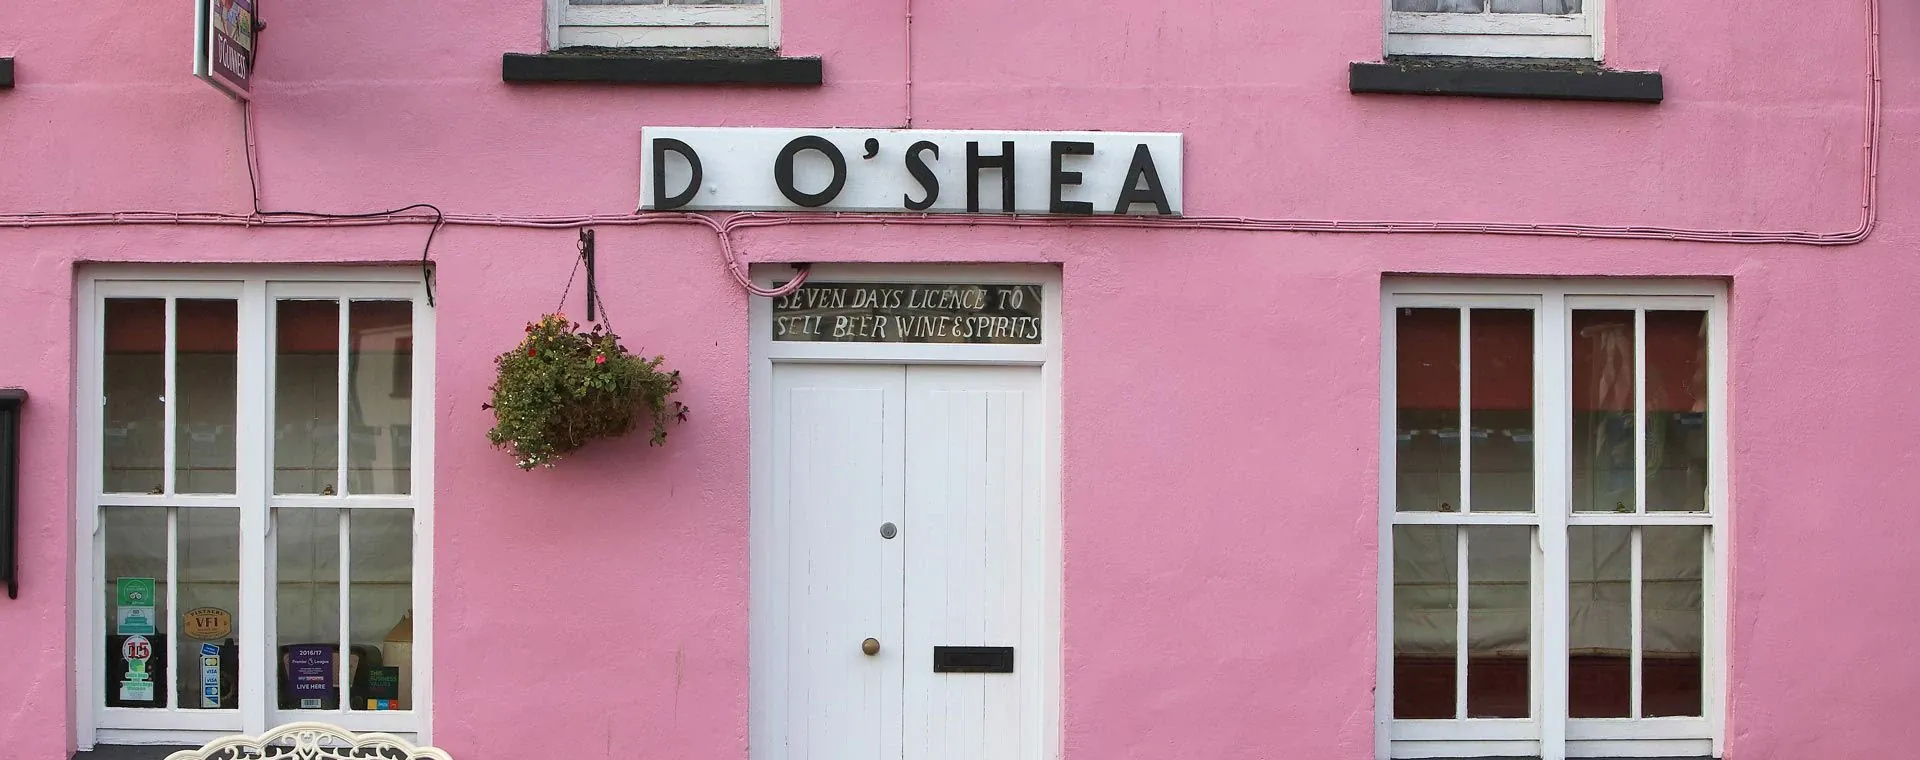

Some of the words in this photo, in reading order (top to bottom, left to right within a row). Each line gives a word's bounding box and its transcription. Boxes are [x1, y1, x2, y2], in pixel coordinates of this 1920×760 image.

[653, 138, 702, 211] D
[774, 135, 1172, 215] O'SHEA
[778, 288, 847, 309] SEVEN
[852, 288, 904, 309] DAYS
[908, 289, 988, 309] LICENCE
[998, 286, 1024, 310] TO
[833, 315, 887, 339] BEER
[895, 315, 949, 338] WINE
[963, 316, 1040, 339] SPIRITS
[195, 617, 218, 628] VFI
